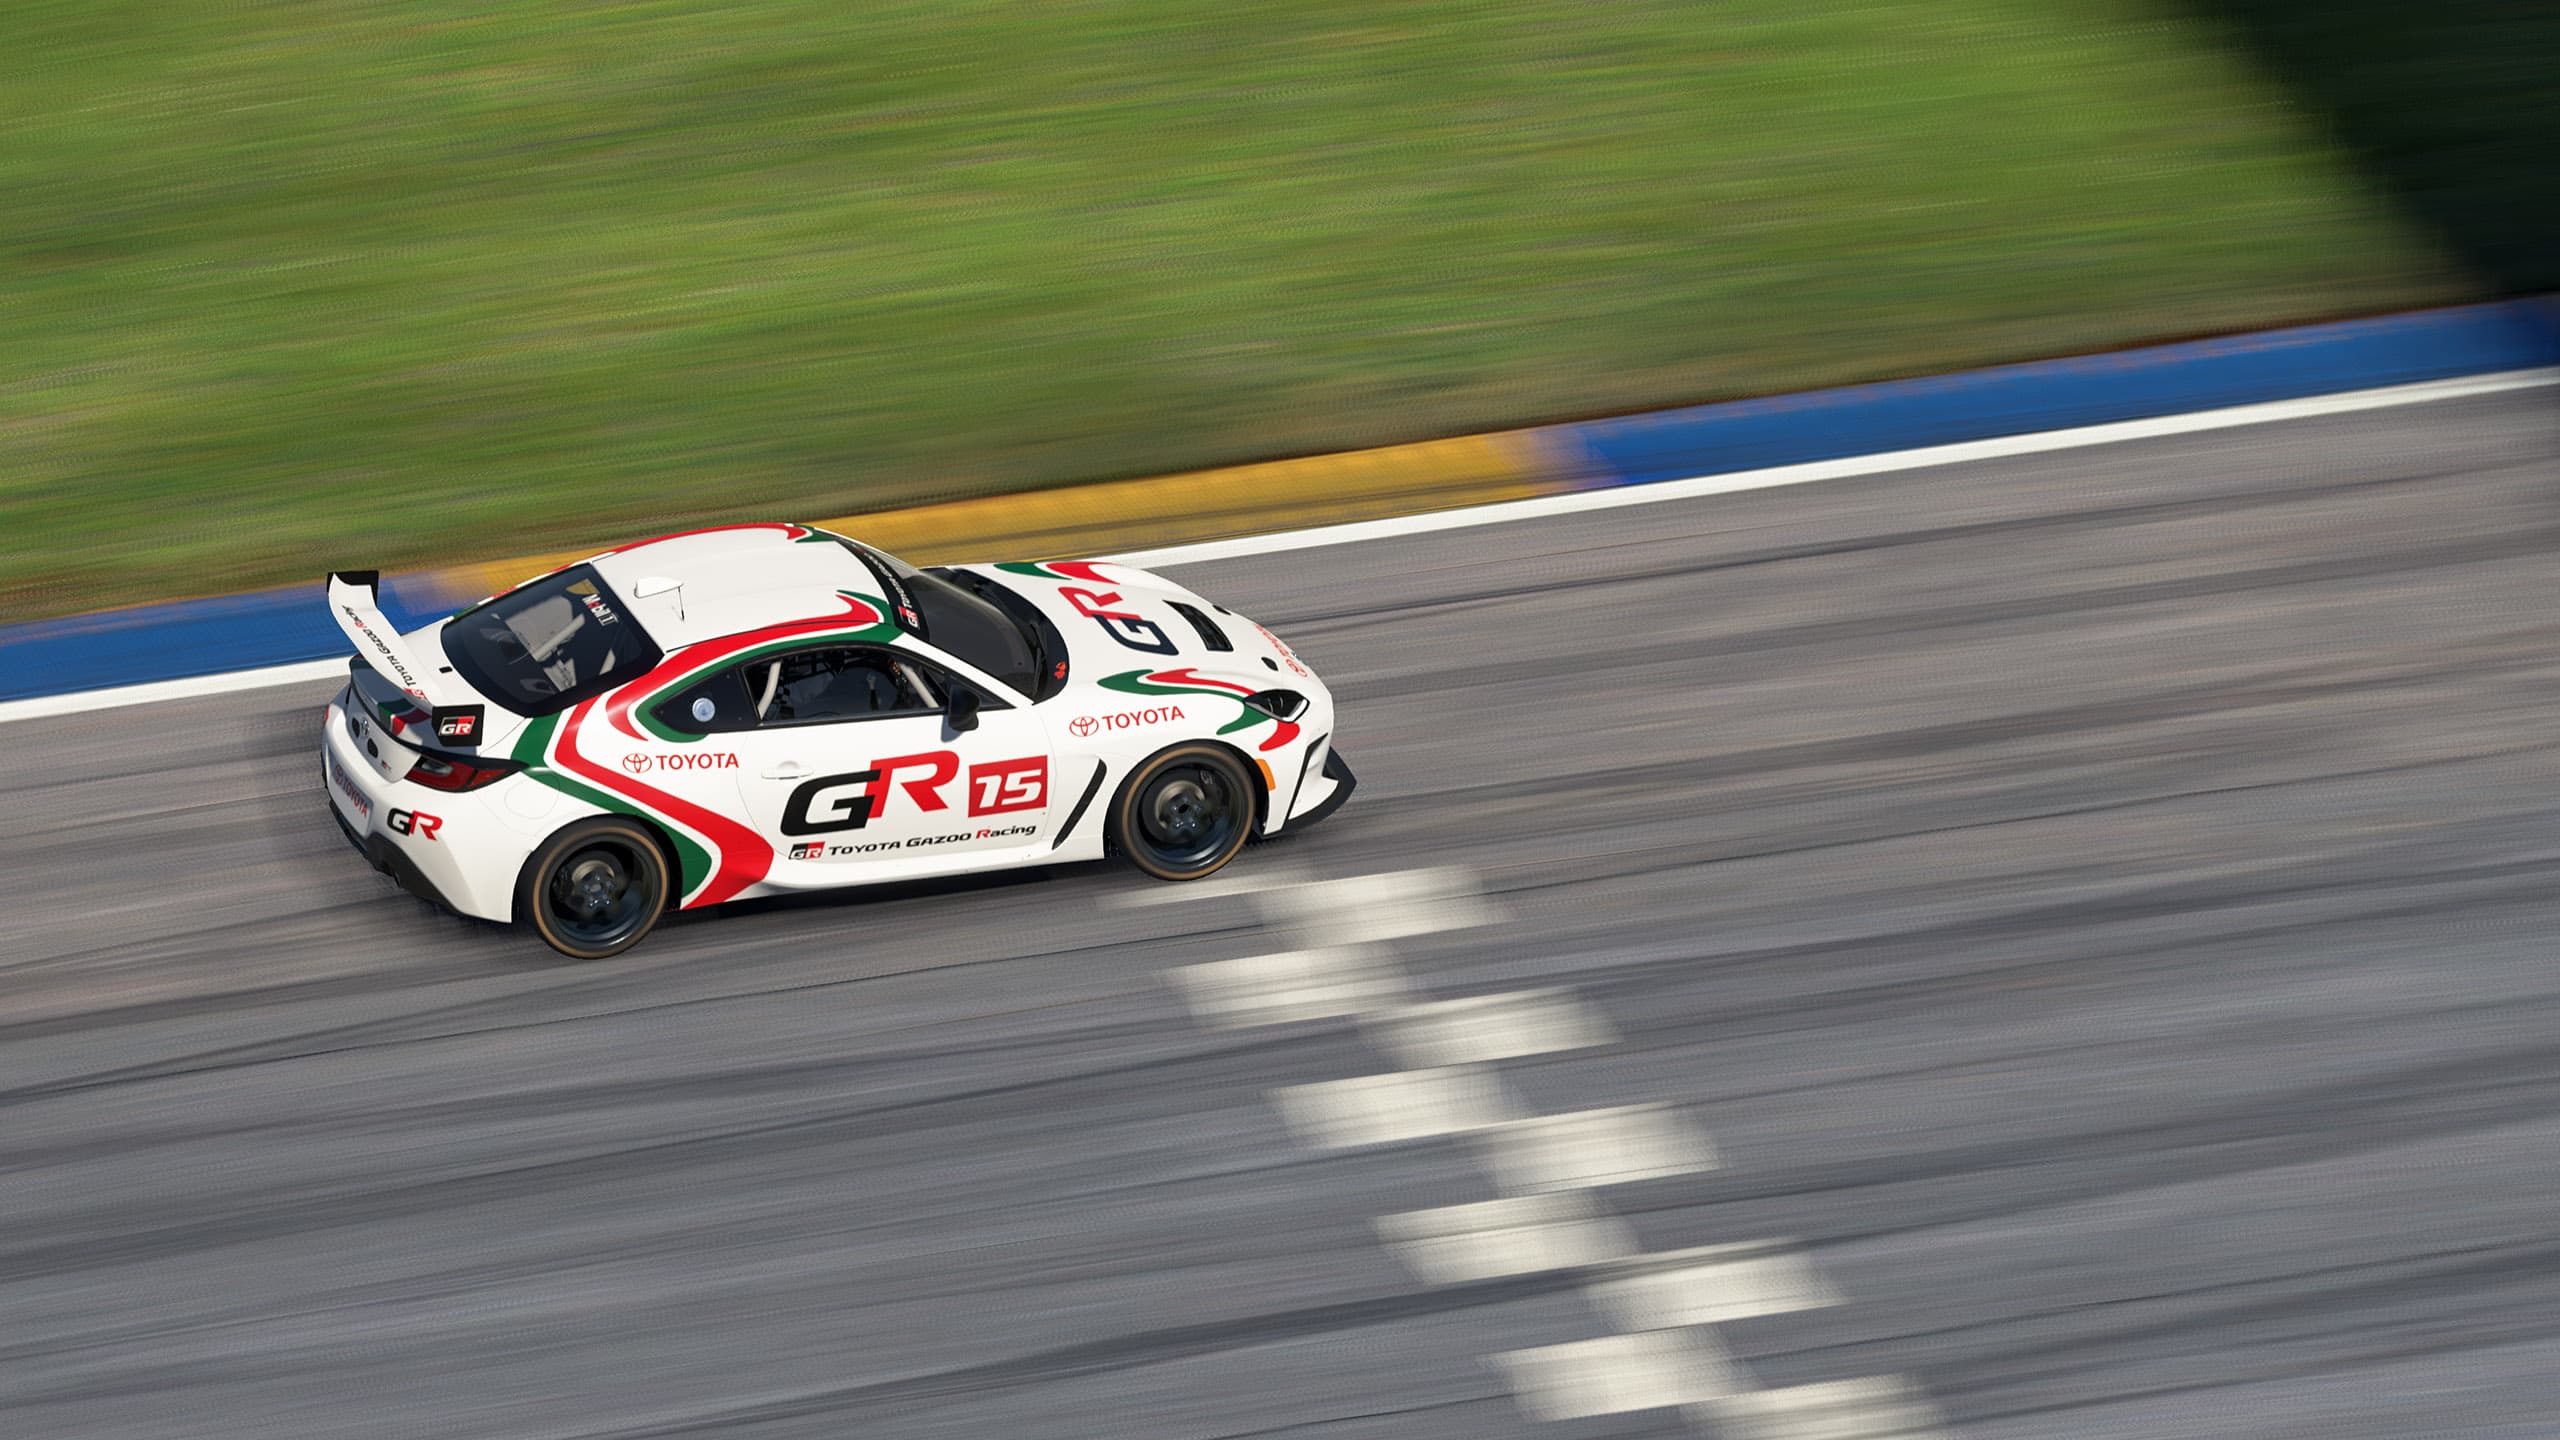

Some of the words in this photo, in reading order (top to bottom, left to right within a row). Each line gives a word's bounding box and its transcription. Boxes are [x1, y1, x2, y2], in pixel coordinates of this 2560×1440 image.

[582, 593, 611, 618] Mobil
[1057, 586, 1180, 656] GR
[387, 655, 417, 687] TOYOTA
[440, 721, 474, 736] GR
[1101, 705, 1186, 731] TOYOTA
[655, 753, 740, 770] TOYOTA
[342, 776, 369, 818] TOYOTA
[780, 749, 960, 837] GR
[975, 767, 1043, 809] 15
[386, 807, 443, 841] GR
[789, 846, 823, 860] GR
[828, 840, 901, 856] TOYOTA
[906, 832, 972, 848] GAZOO
[975, 824, 1037, 841] Racing
